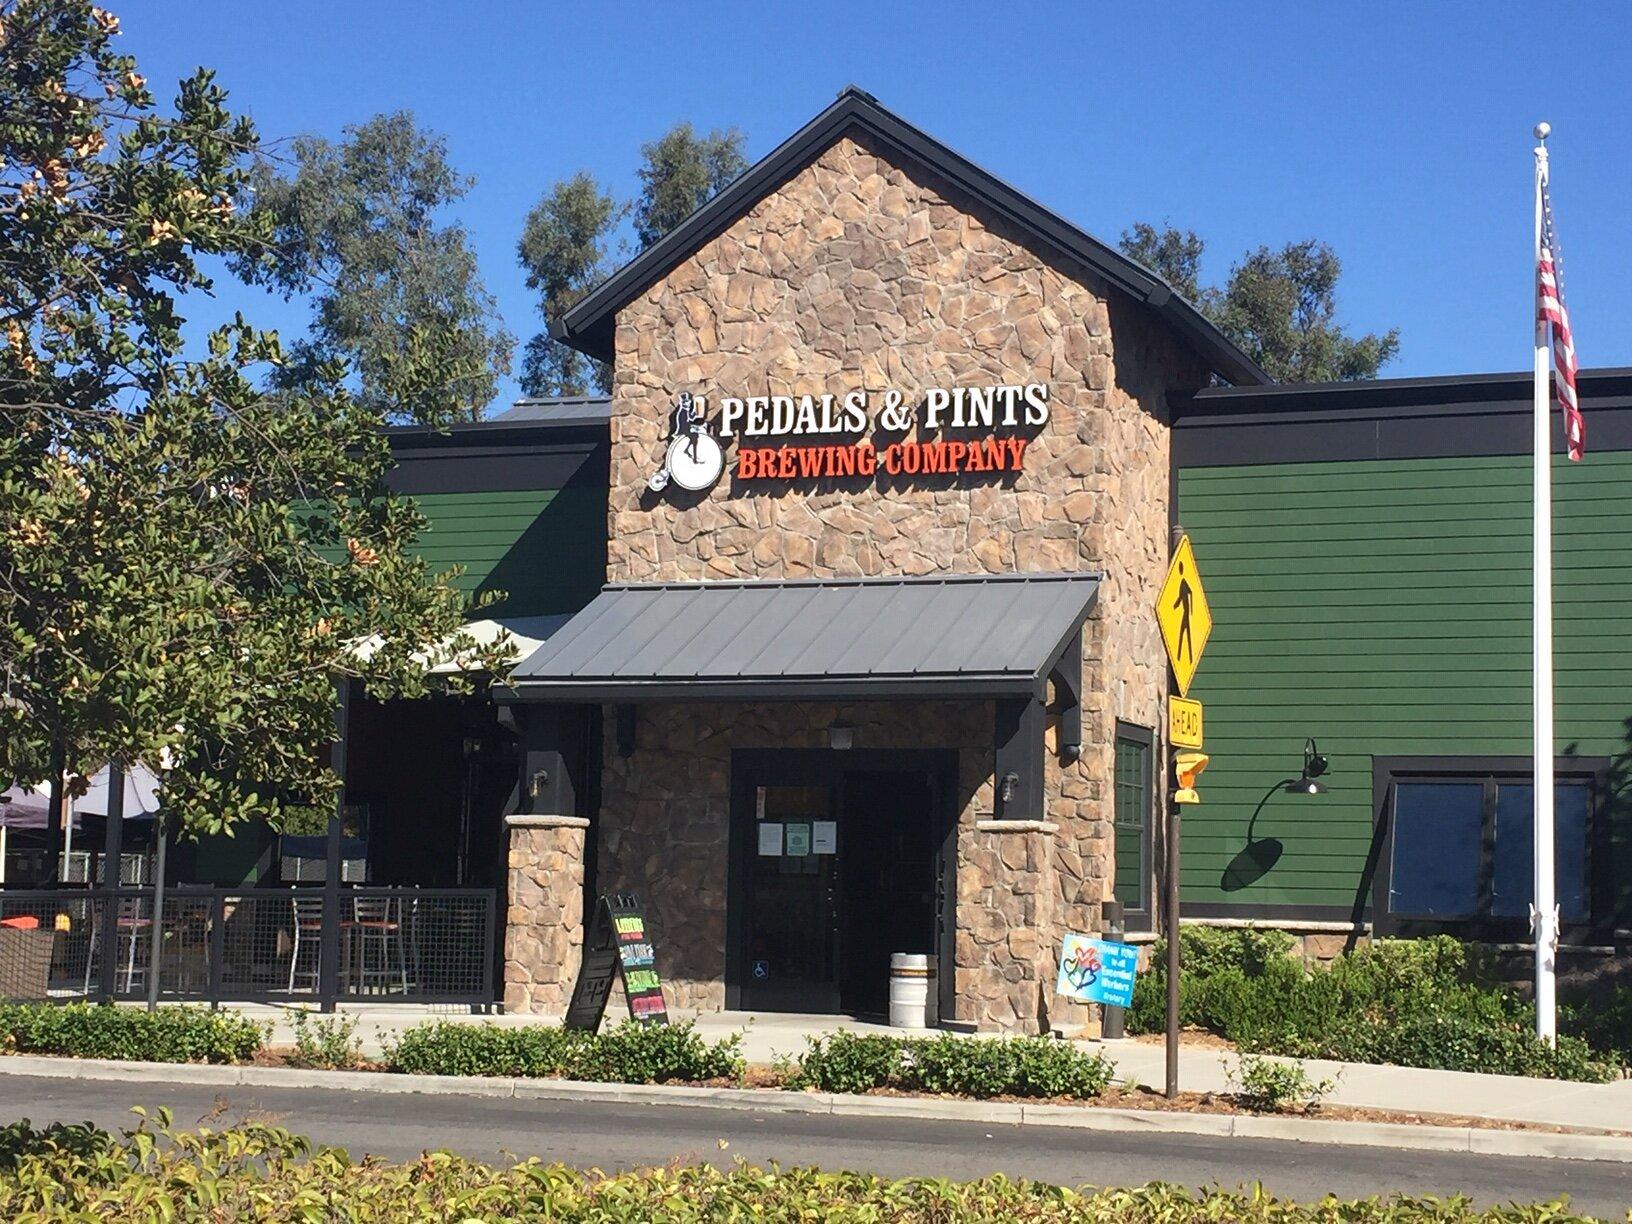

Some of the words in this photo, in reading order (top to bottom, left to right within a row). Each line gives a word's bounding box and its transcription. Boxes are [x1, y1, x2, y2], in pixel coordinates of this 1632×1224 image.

[720, 392, 867, 437] PEDALS
[881, 389, 912, 431] &
[925, 384, 1050, 428] PINTS
[738, 447, 876, 479] BREWING
[886, 440, 1027, 474] COMPANY
[1172, 708, 1198, 737] AHEAD
